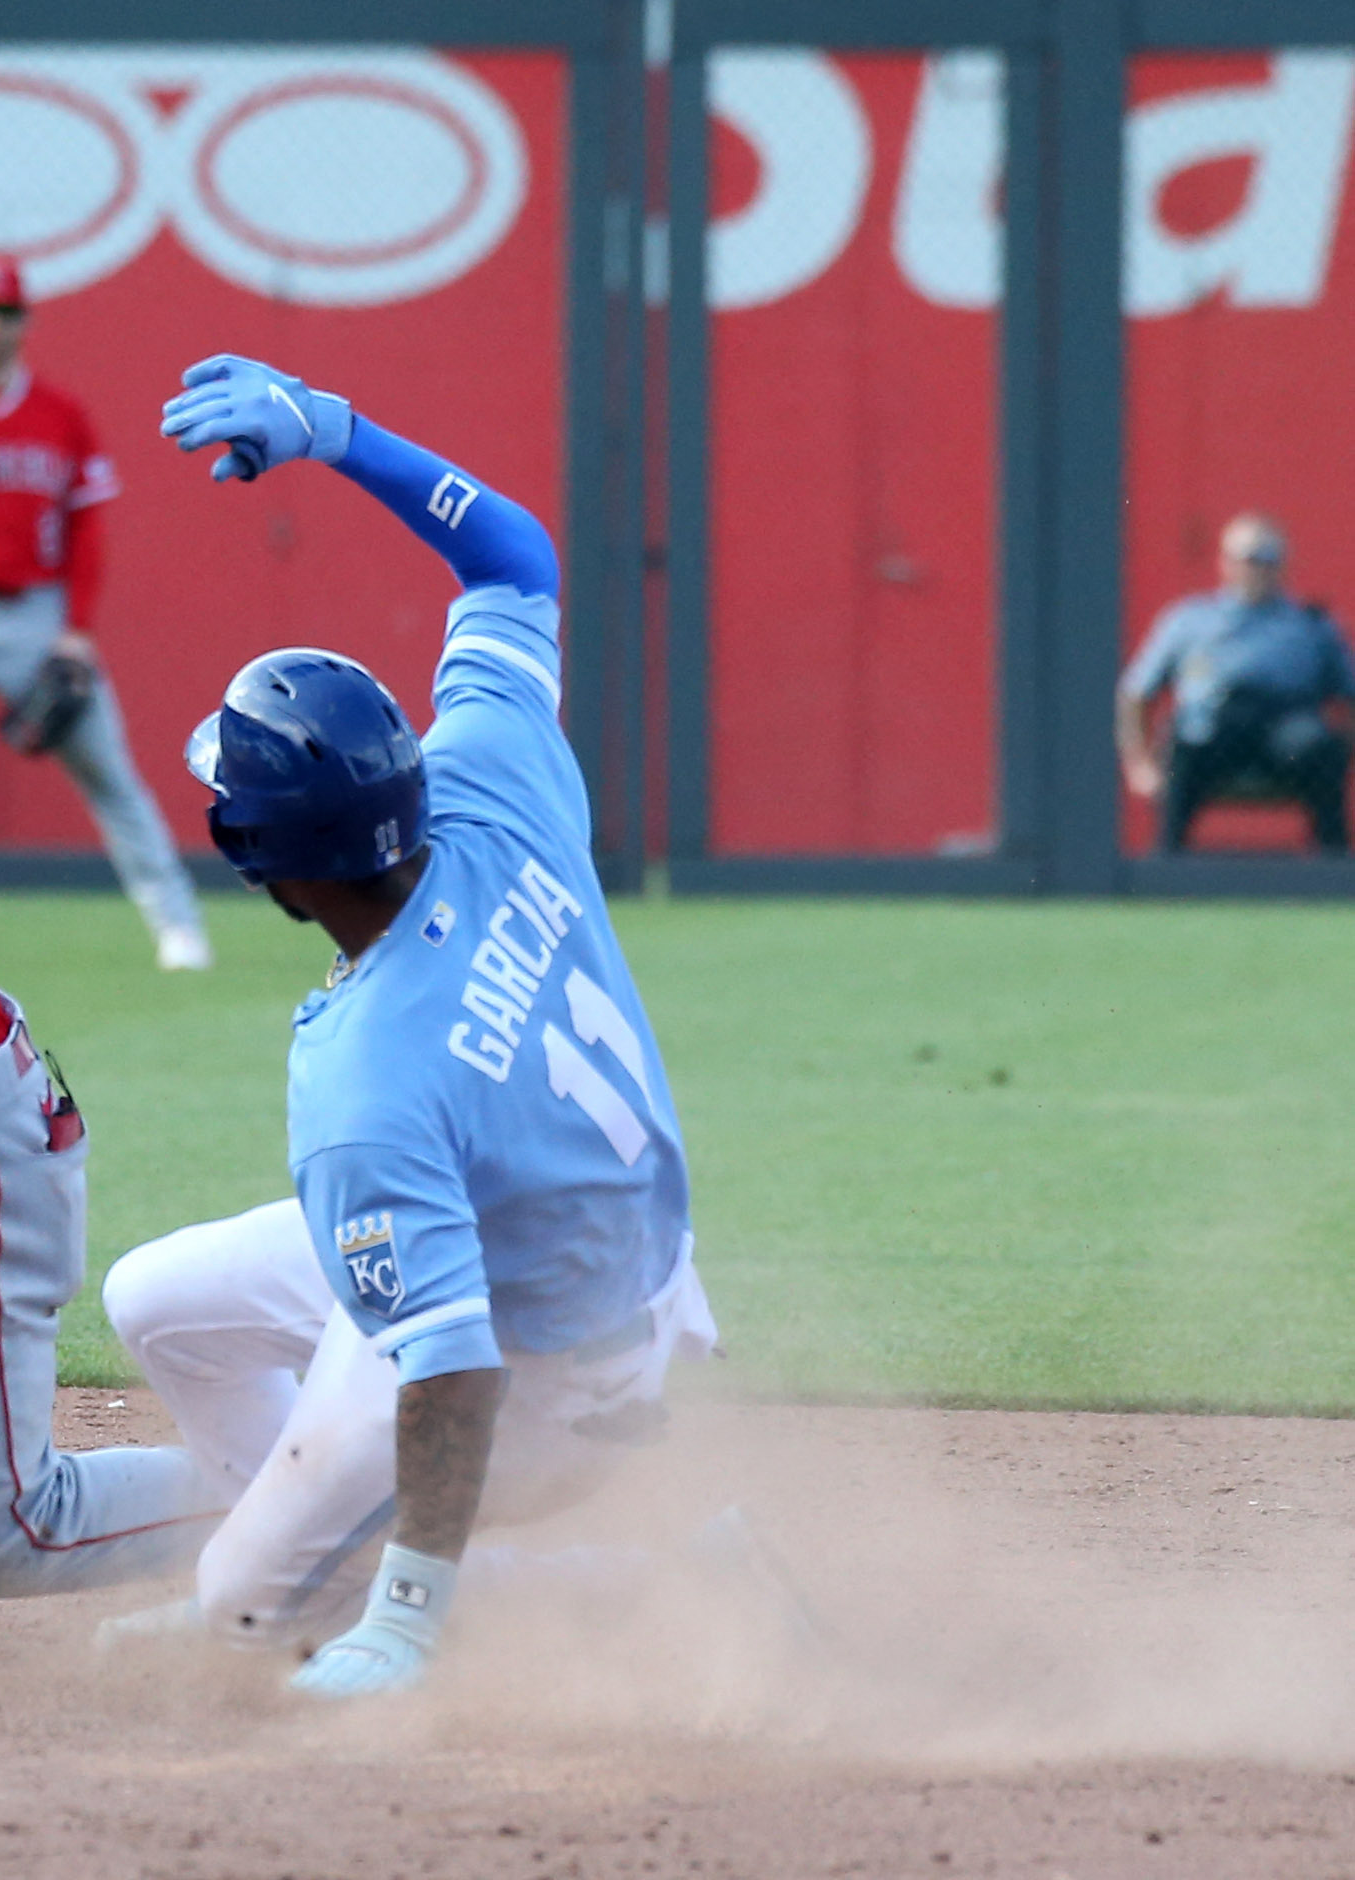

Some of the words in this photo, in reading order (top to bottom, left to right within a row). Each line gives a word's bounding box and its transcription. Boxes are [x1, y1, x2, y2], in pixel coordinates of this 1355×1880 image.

[373, 818, 400, 854] 11
[446, 857, 585, 1085] GARCIA
[541, 966, 653, 1169] 11
[347, 1255, 400, 1298] KC
